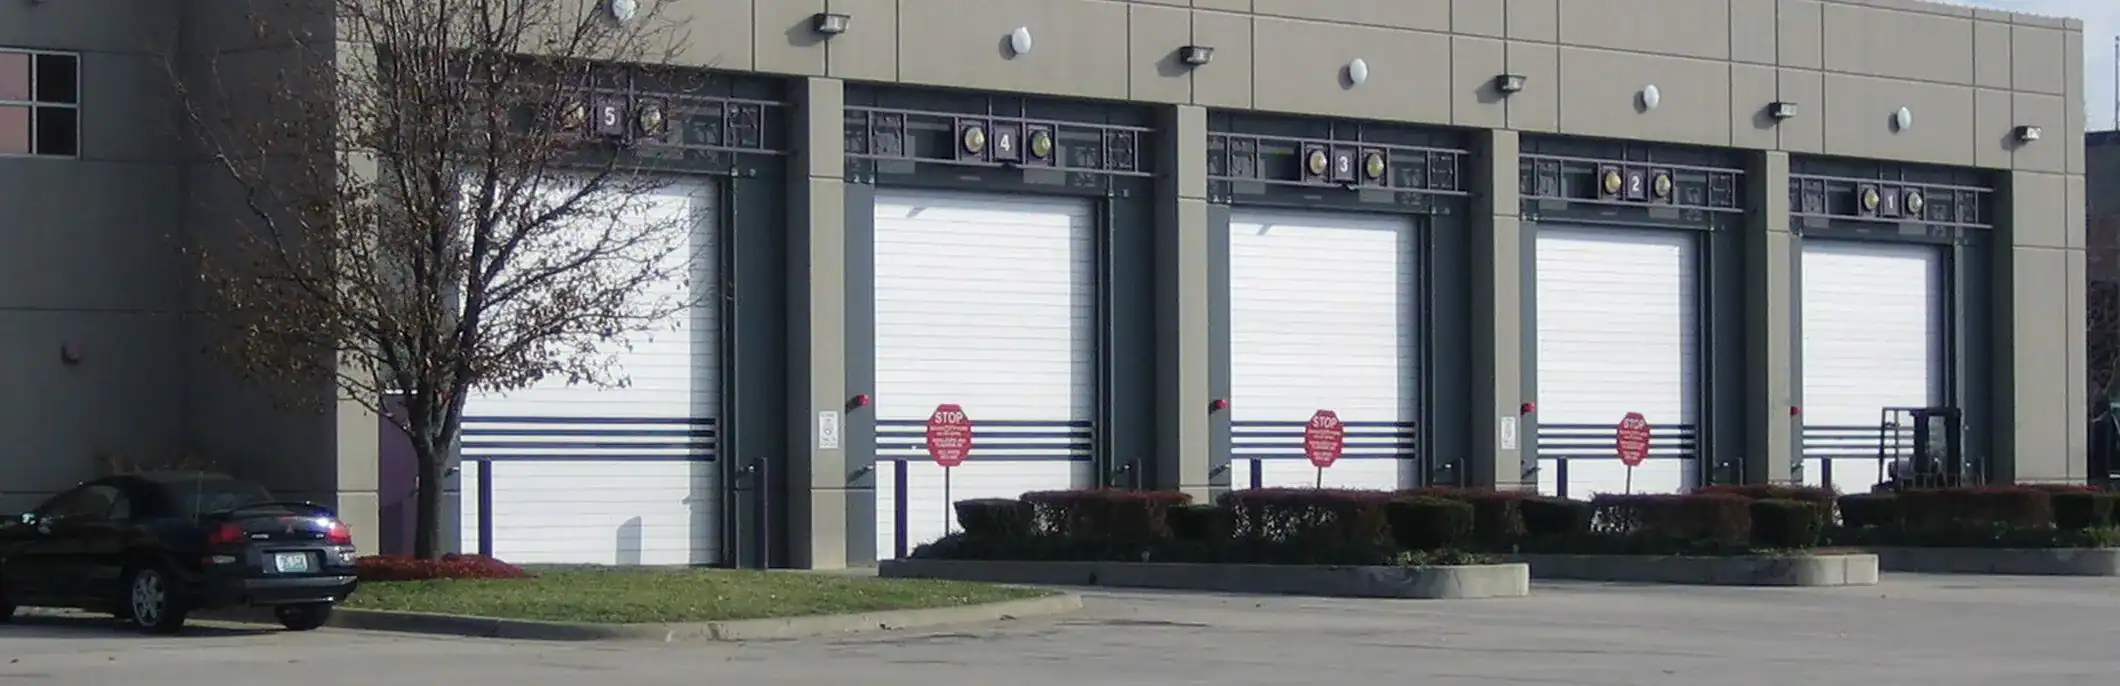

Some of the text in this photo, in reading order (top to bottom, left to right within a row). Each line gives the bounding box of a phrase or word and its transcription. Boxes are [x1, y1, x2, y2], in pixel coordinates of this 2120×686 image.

[604, 106, 616, 126] 5
[1000, 134, 1010, 151] 4
[1339, 156, 1348, 173] 3
[1631, 175, 1640, 192] 2
[1887, 194, 1893, 209] 1
[934, 411, 963, 424] STOP
[1312, 416, 1338, 428] STOP
[1623, 418, 1645, 430] STOP
